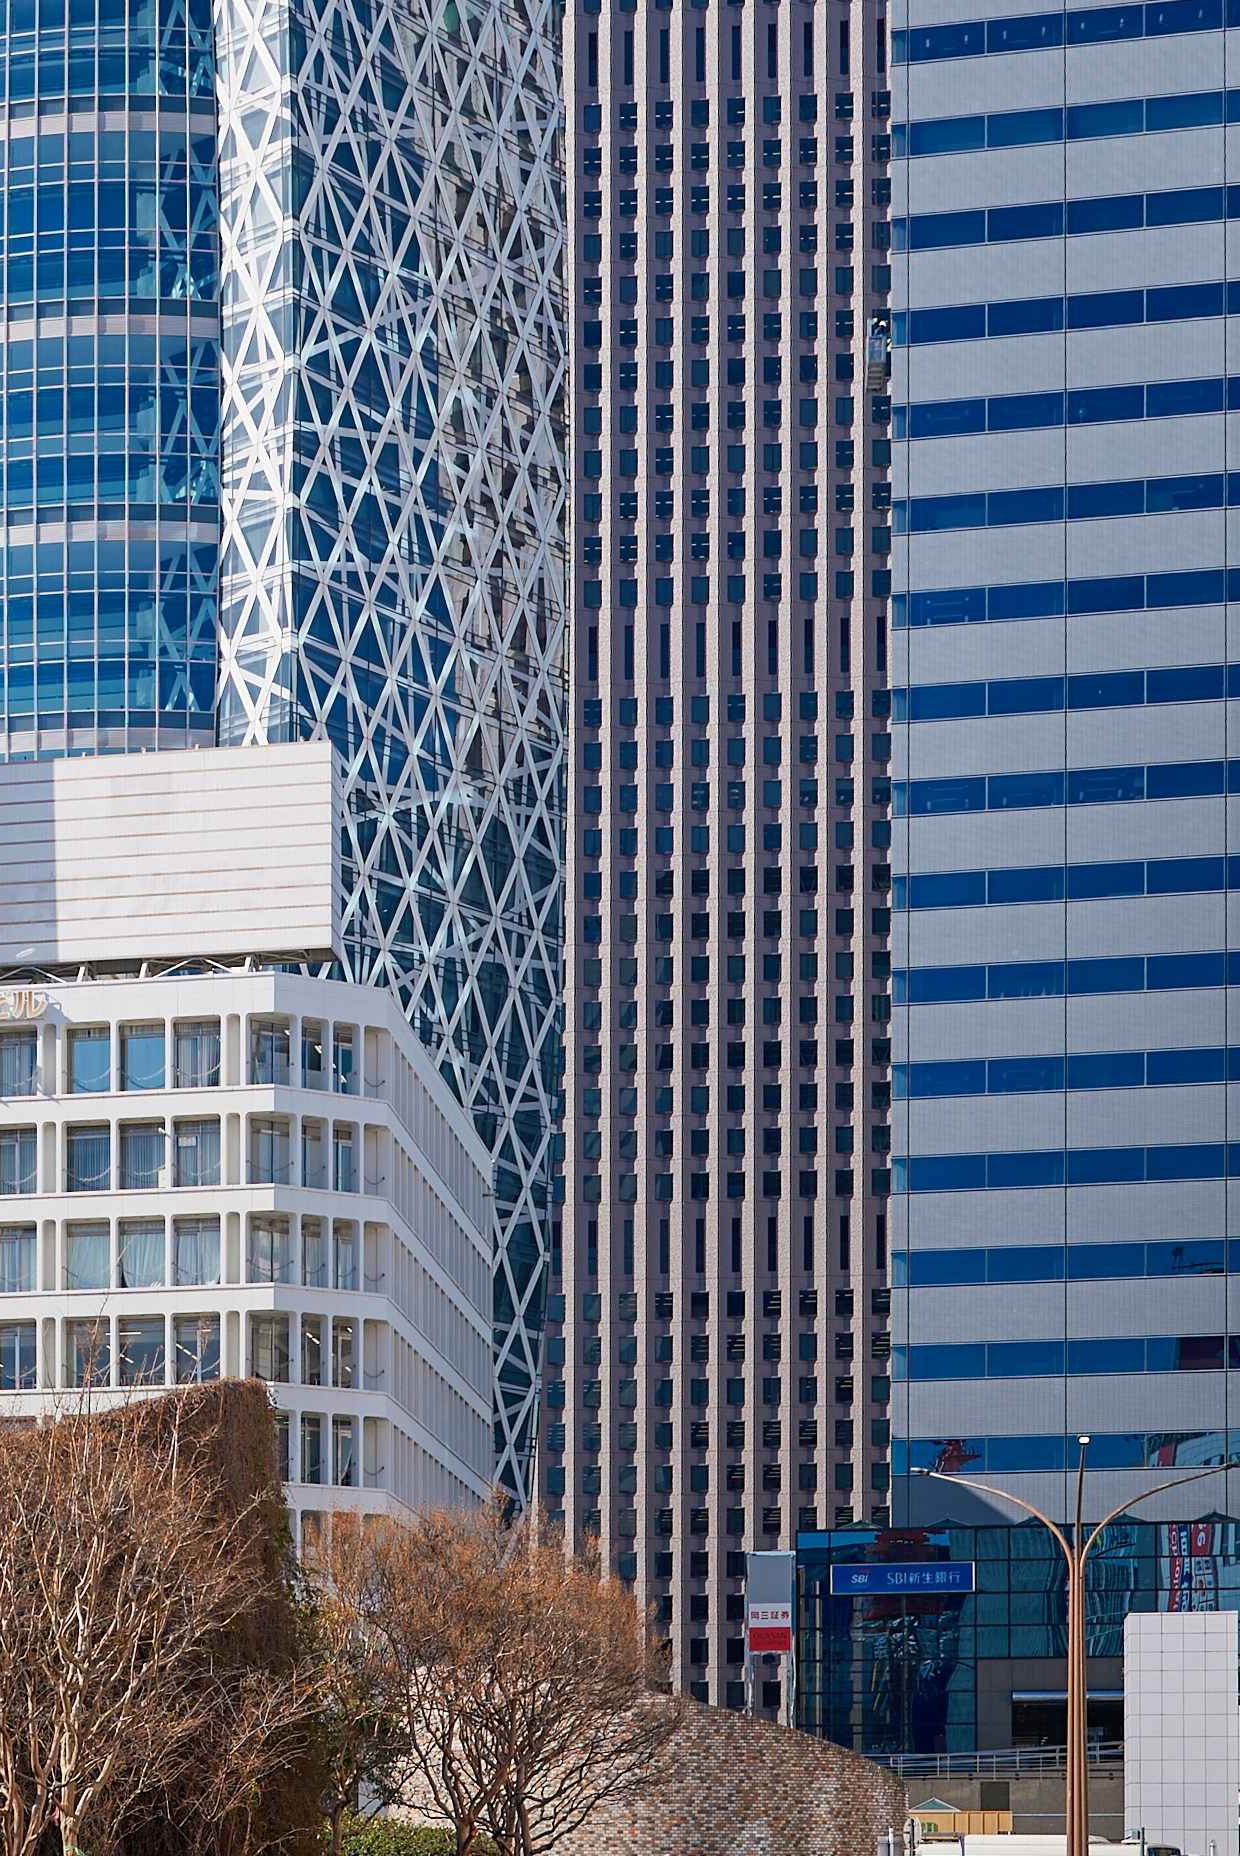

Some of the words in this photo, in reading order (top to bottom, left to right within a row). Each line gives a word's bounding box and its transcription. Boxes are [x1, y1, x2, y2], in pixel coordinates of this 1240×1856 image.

[851, 1574, 868, 1583] SBI
[887, 1571, 960, 1585] SBI新生銀行
